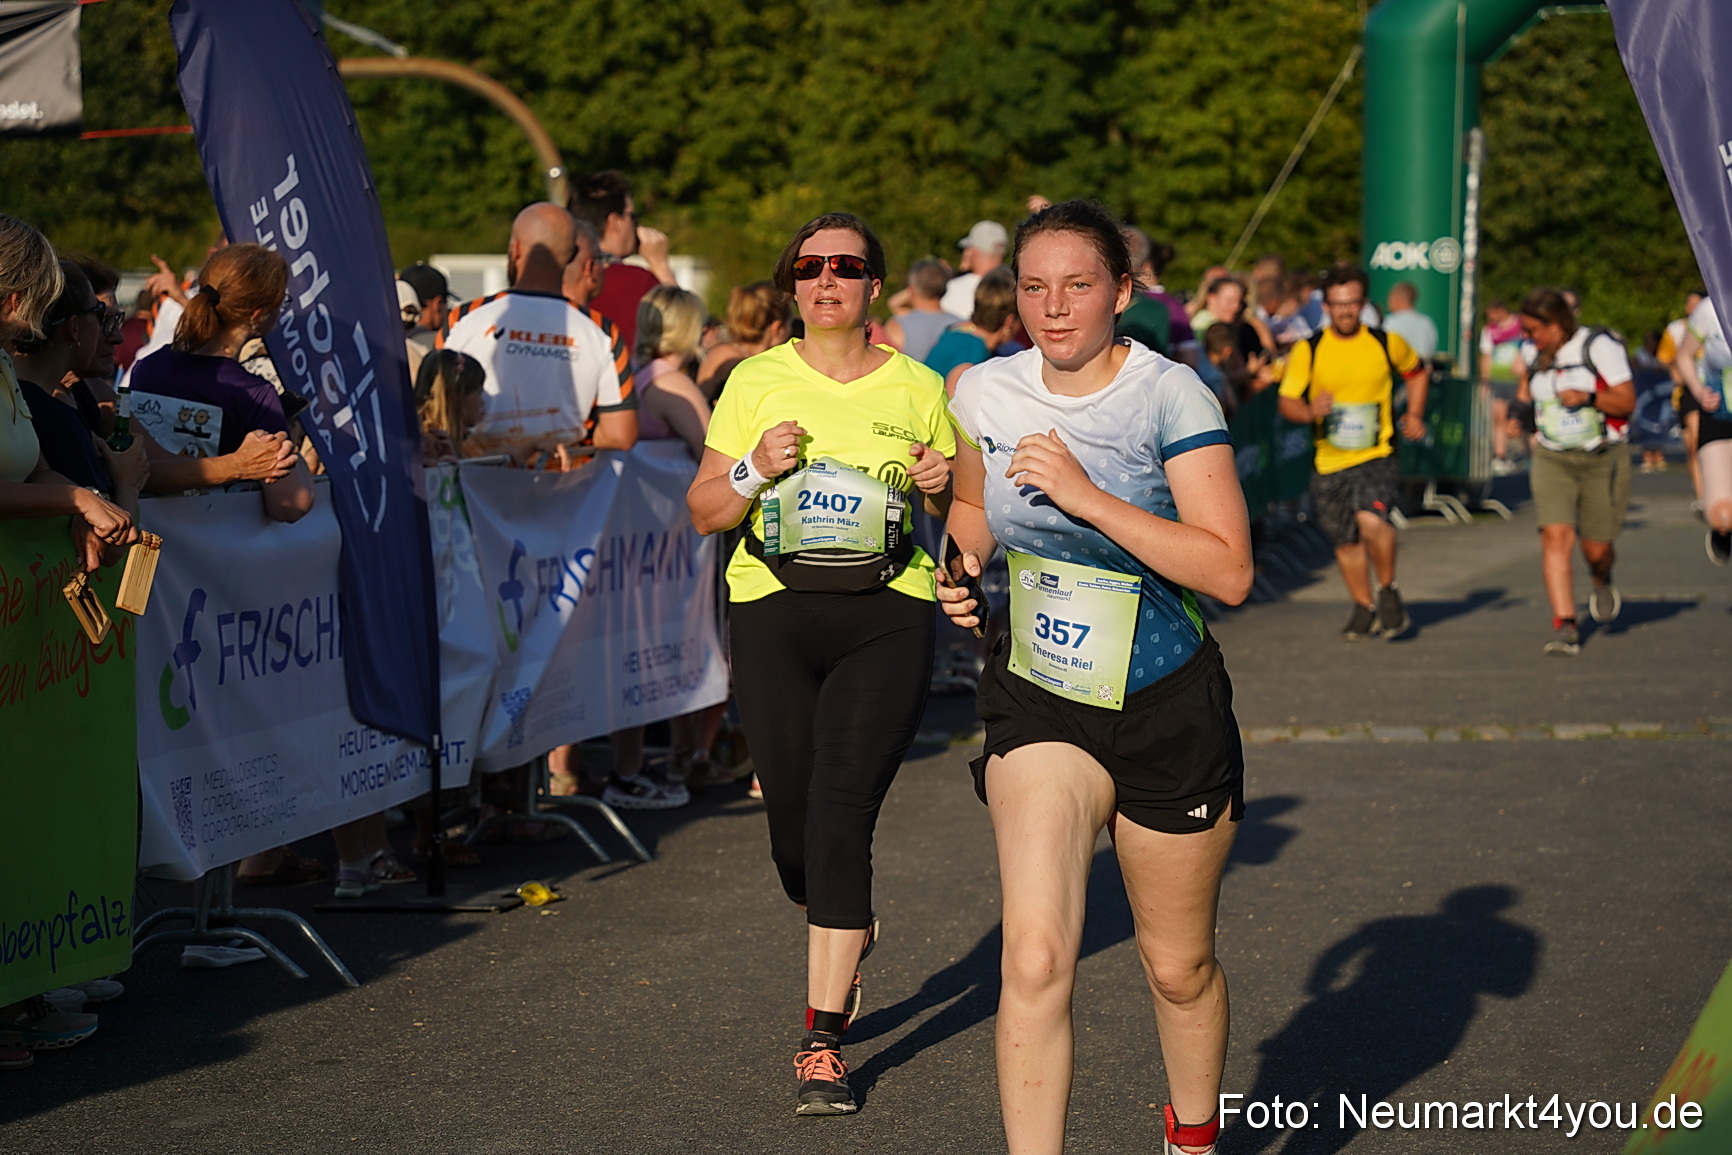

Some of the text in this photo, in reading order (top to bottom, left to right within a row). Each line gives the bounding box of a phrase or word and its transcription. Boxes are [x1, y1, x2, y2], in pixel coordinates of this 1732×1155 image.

[1370, 241, 1431, 271] AOK
[797, 490, 862, 514] 2407
[801, 515, 861, 527] Kathrin März
[887, 523, 896, 549] HILTL
[1035, 583, 1073, 598] Firmenlauf
[1035, 612, 1091, 649] 357
[1032, 642, 1068, 665] Theresa
[1070, 657, 1093, 671] Riel
[339, 727, 377, 758] HEUTE
[202, 783, 259, 817] CORPORATE
[202, 809, 259, 843] CORPORATE
